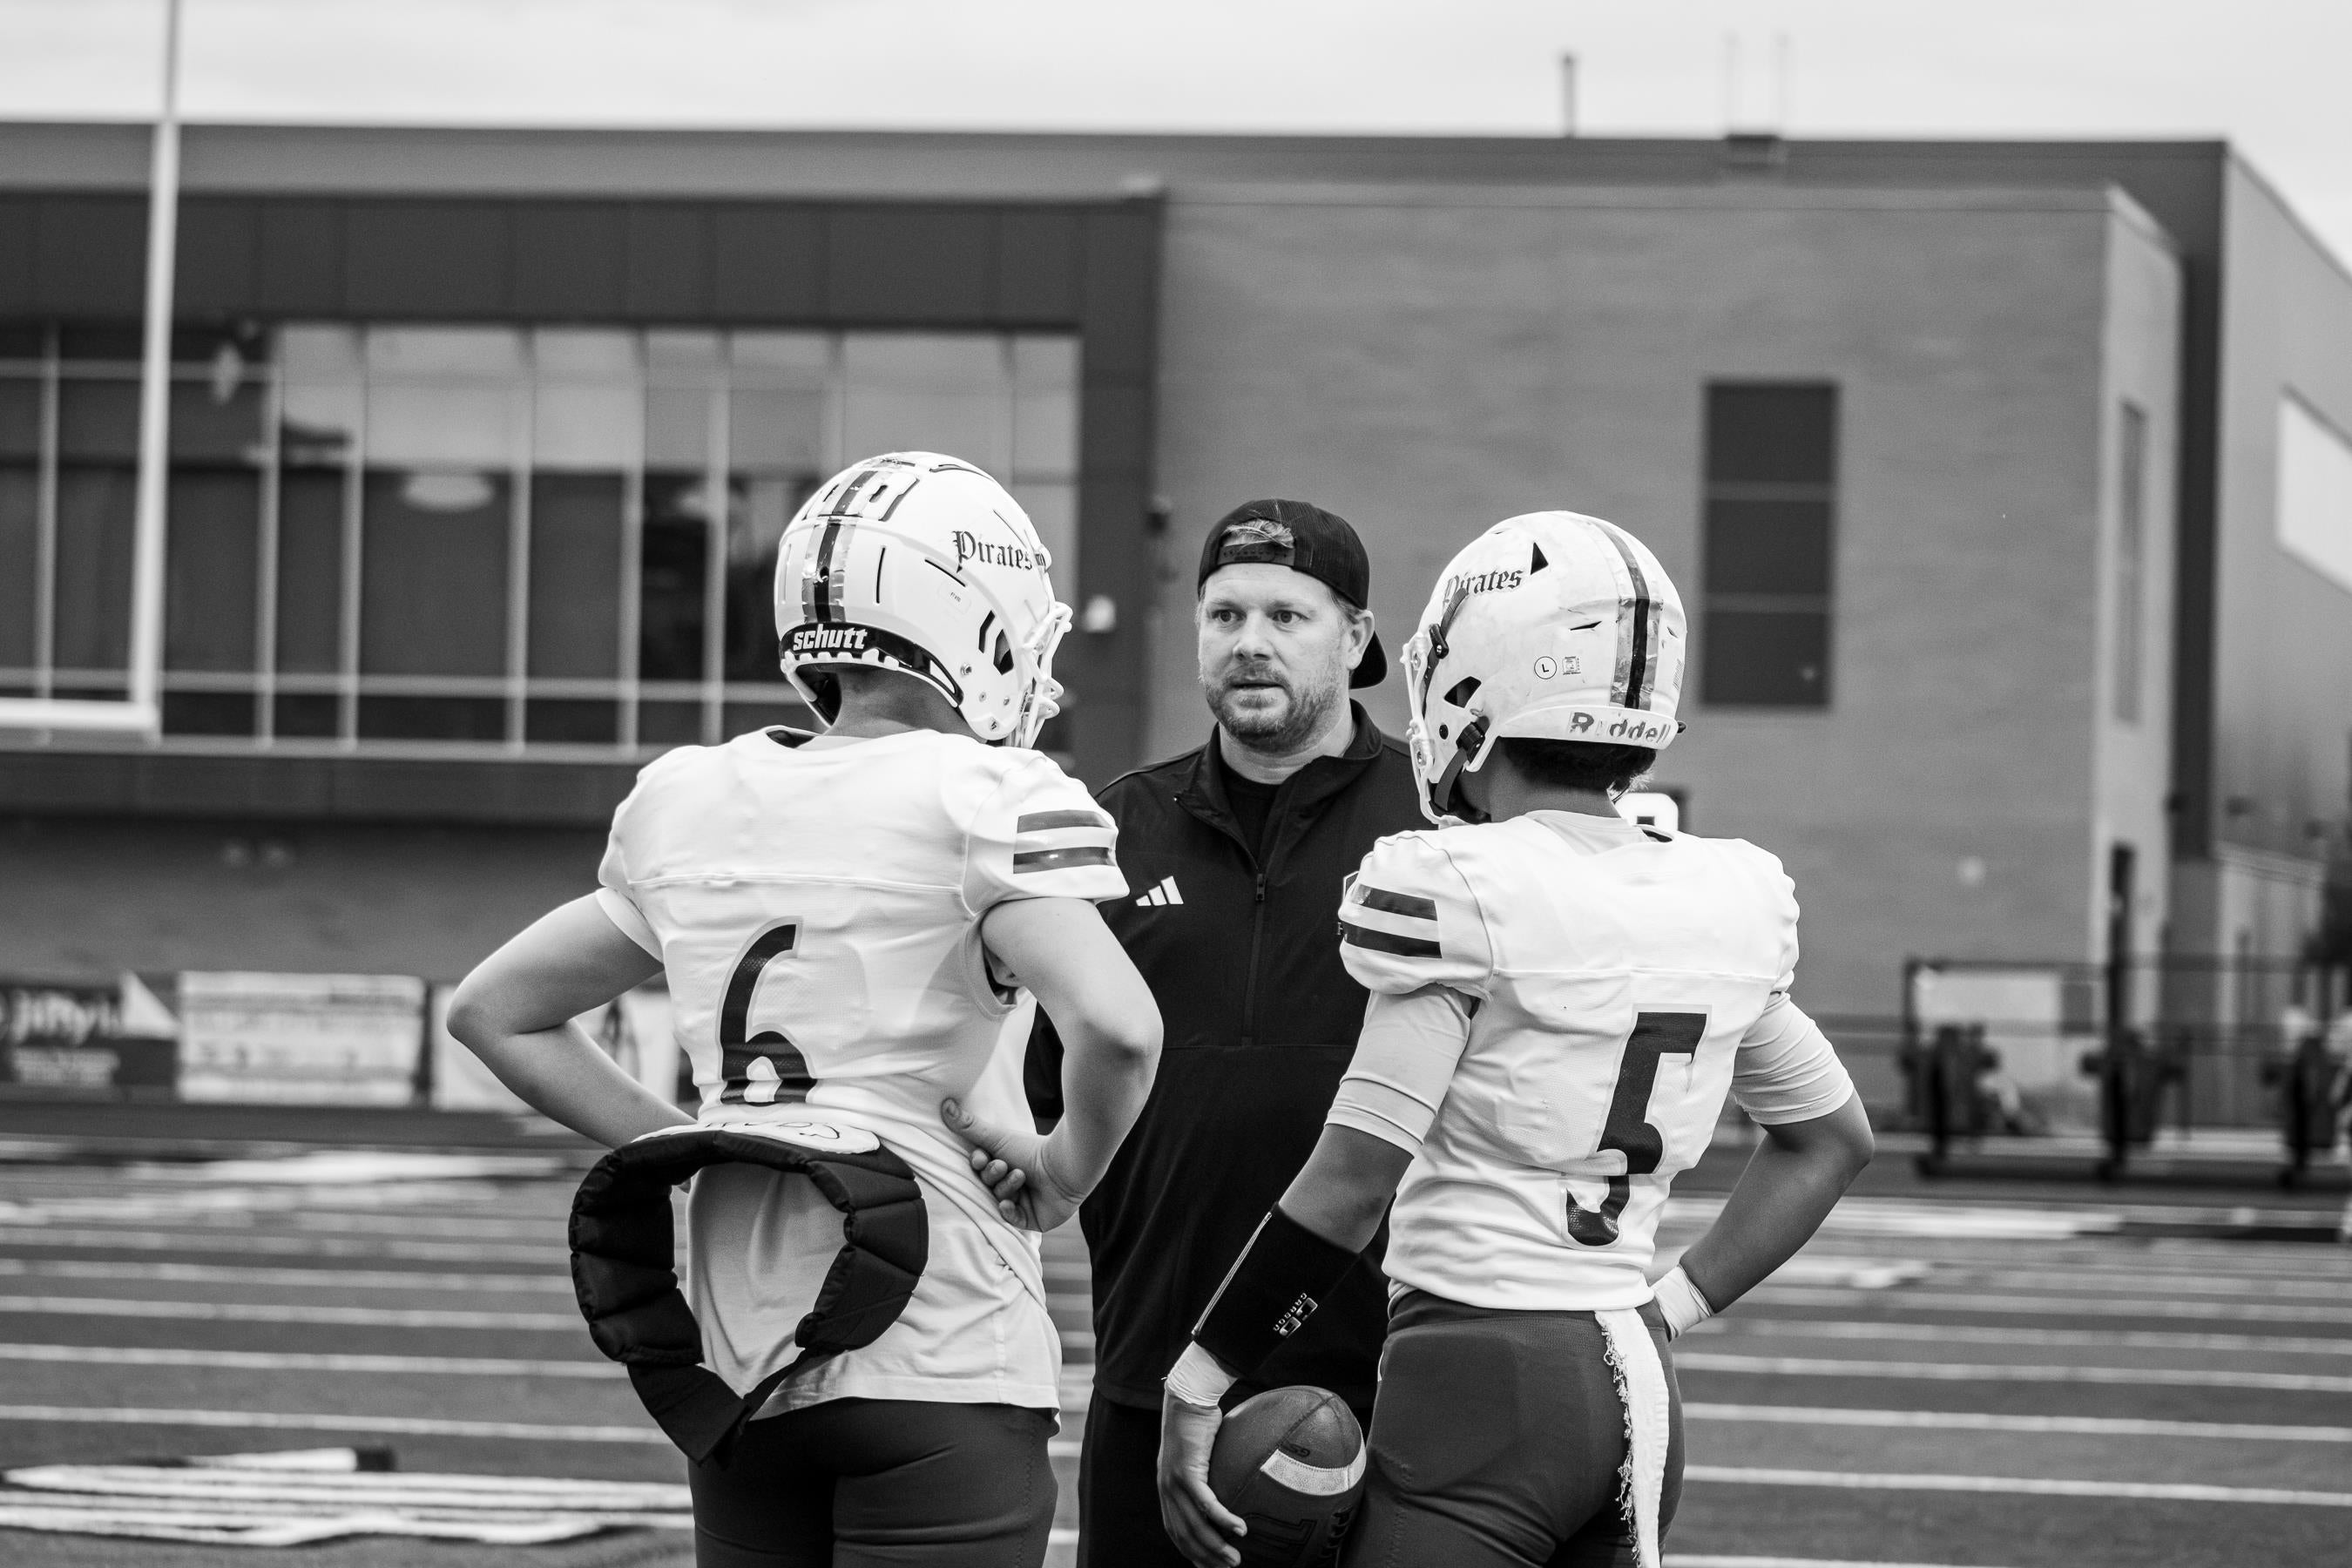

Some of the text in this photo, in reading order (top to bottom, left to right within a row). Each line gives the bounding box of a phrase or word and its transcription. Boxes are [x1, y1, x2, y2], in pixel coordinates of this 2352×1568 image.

[951, 530, 1033, 573] Pirates
[793, 623, 868, 652] schutt
[1542, 663, 1550, 672] L
[1570, 712, 1672, 743] Rddell
[719, 920, 818, 1107] 6
[1565, 1011, 1707, 1247] 5
